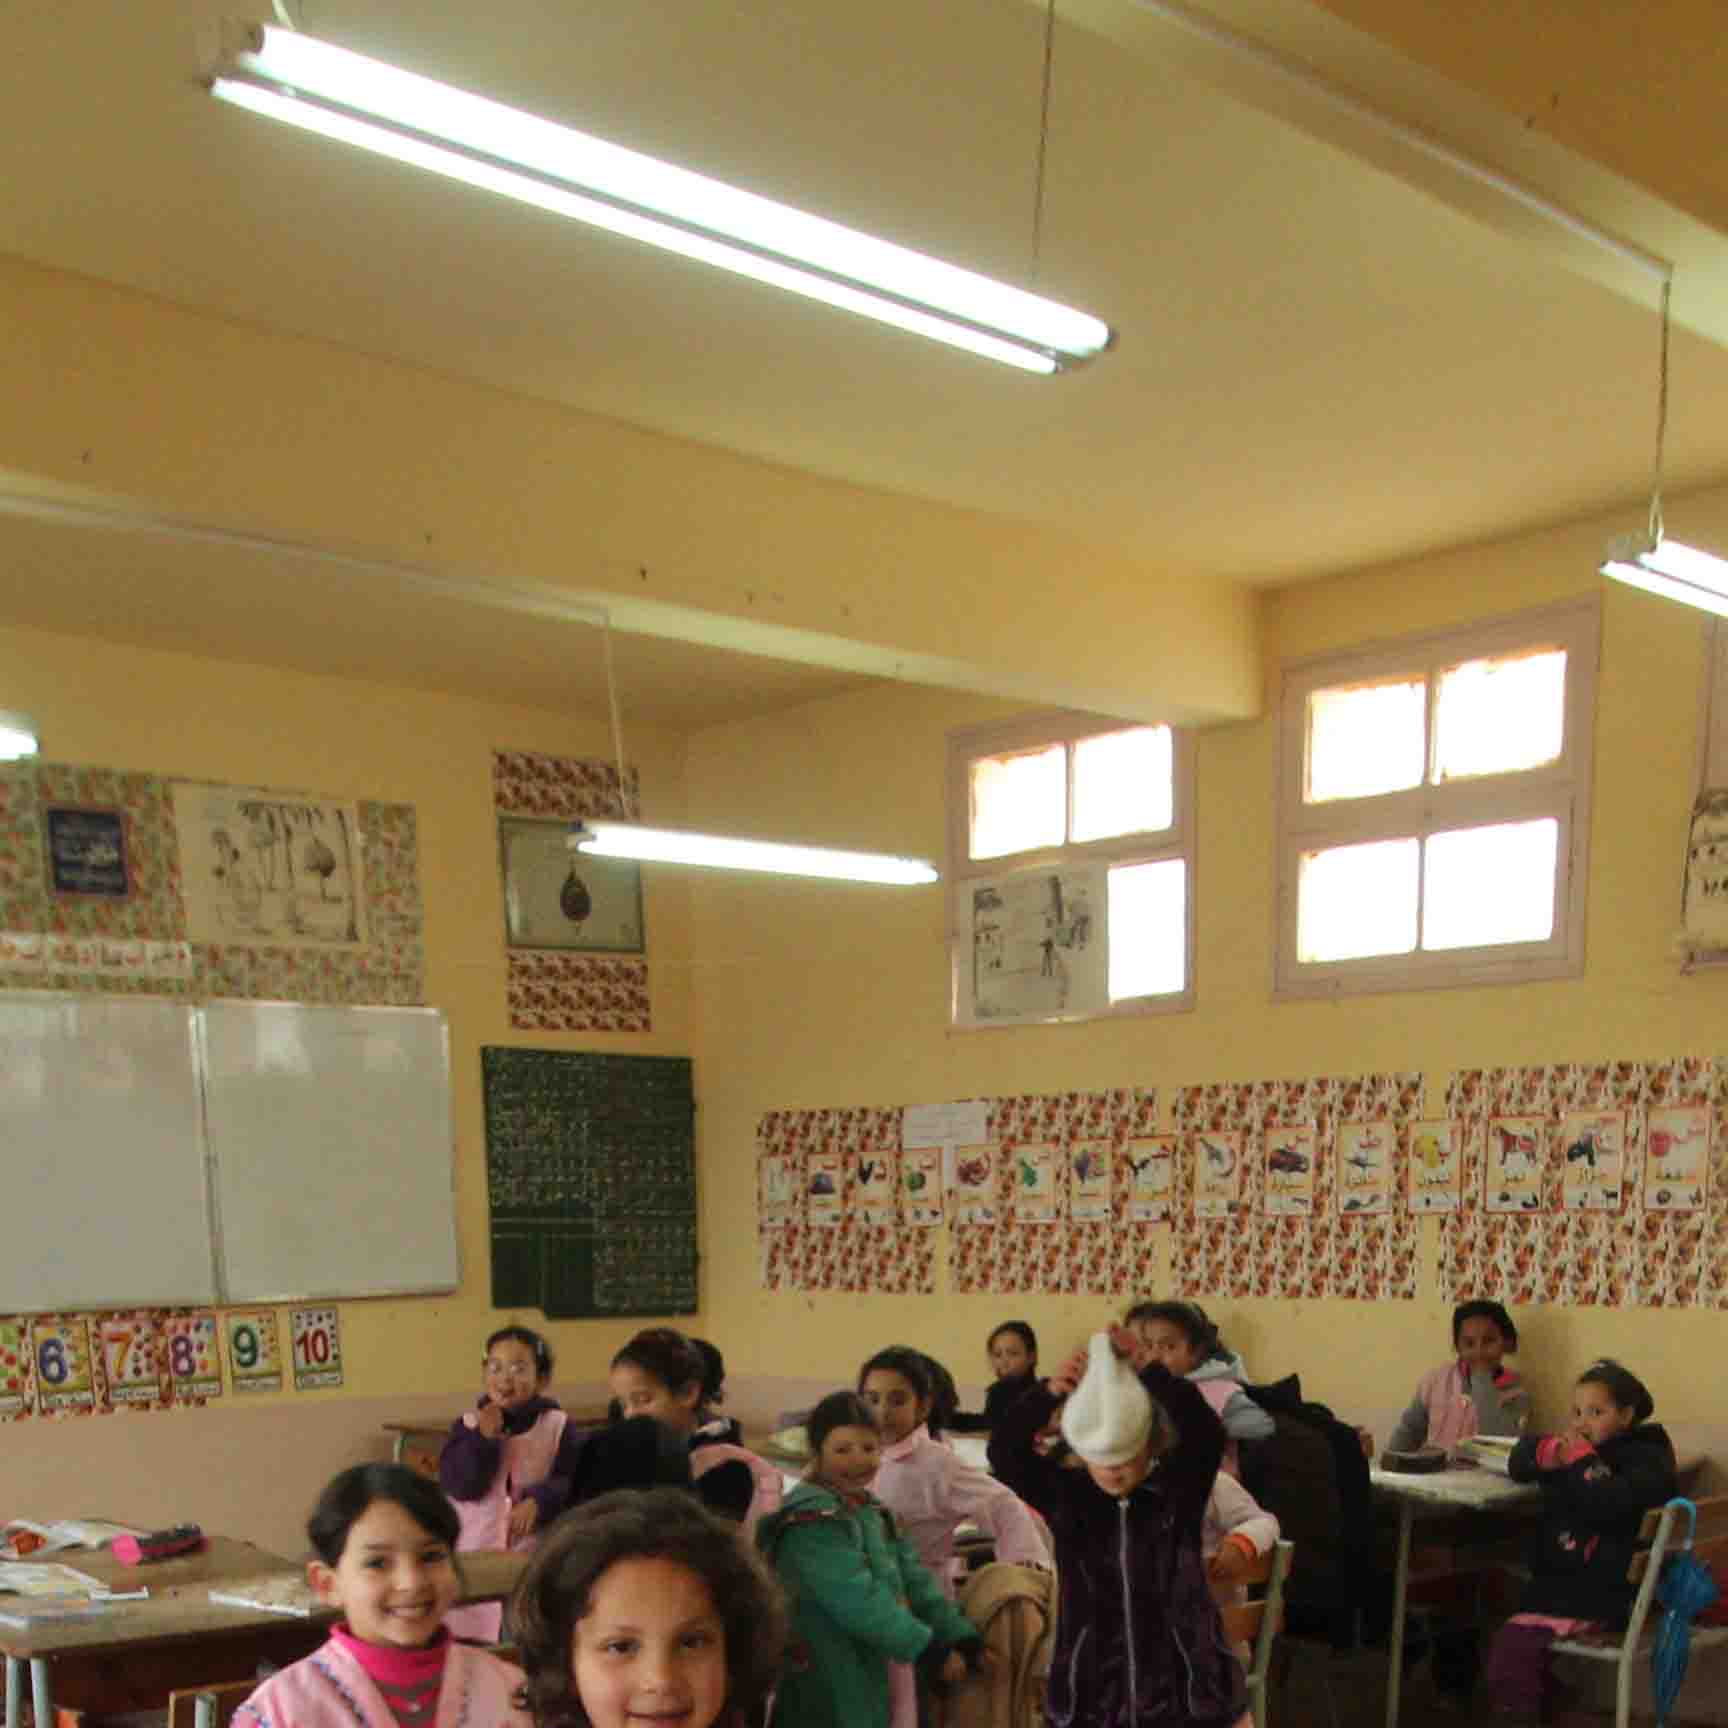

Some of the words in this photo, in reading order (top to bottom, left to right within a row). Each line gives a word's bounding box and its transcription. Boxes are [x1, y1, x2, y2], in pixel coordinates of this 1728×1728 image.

[38, 1337, 69, 1385] 6
[111, 1330, 135, 1379] 7
[171, 1334, 197, 1378] 8
[232, 1324, 259, 1368] 9
[295, 1328, 330, 1365] 10
